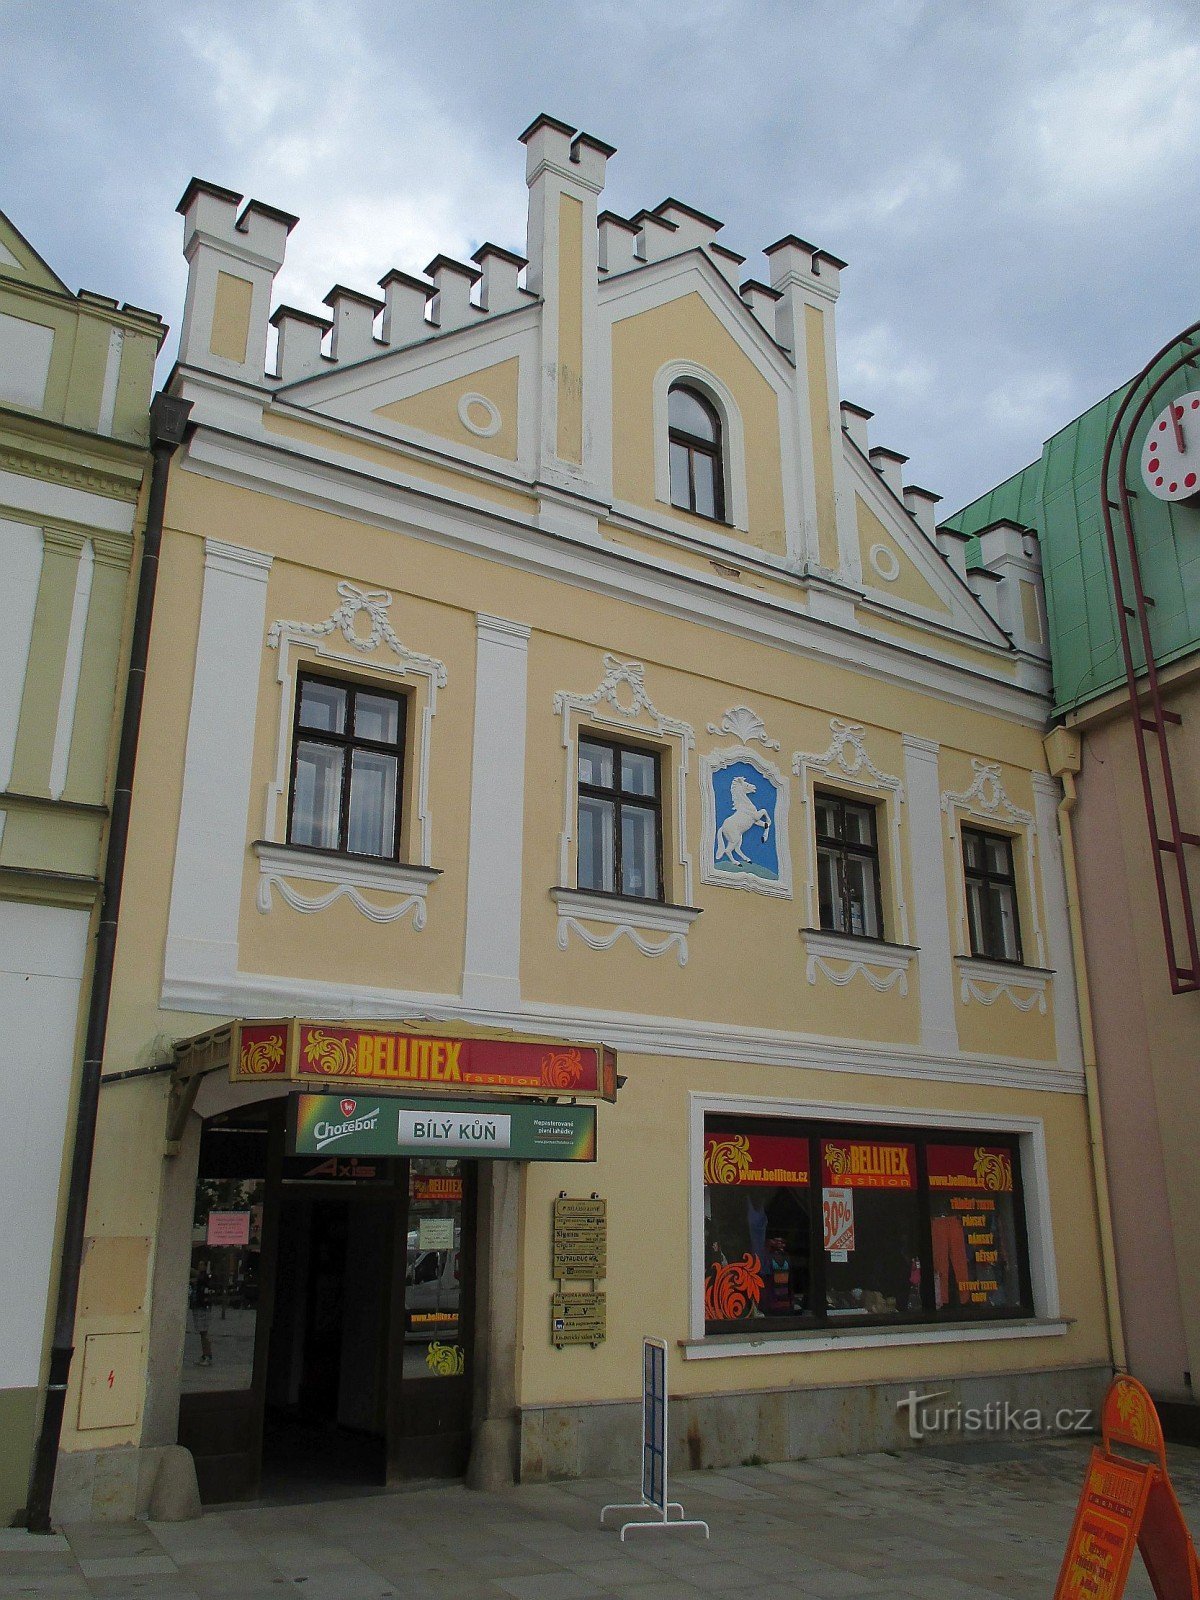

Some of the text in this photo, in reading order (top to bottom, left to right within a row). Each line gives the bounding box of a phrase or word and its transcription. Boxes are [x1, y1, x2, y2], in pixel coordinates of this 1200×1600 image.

[357, 1034, 463, 1082] BELLITEX
[464, 1073, 540, 1087] fashion
[413, 1118, 497, 1141] BÍLÝ KŮŇ
[850, 1145, 910, 1175] BELLITEX
[739, 1168, 808, 1183] www.bellitex.cz
[832, 1174, 910, 1188] fashion
[429, 1178, 463, 1194] BELLITEX
[823, 1200, 851, 1247] 30%
[411, 1312, 459, 1323] www.bellitex.cz
